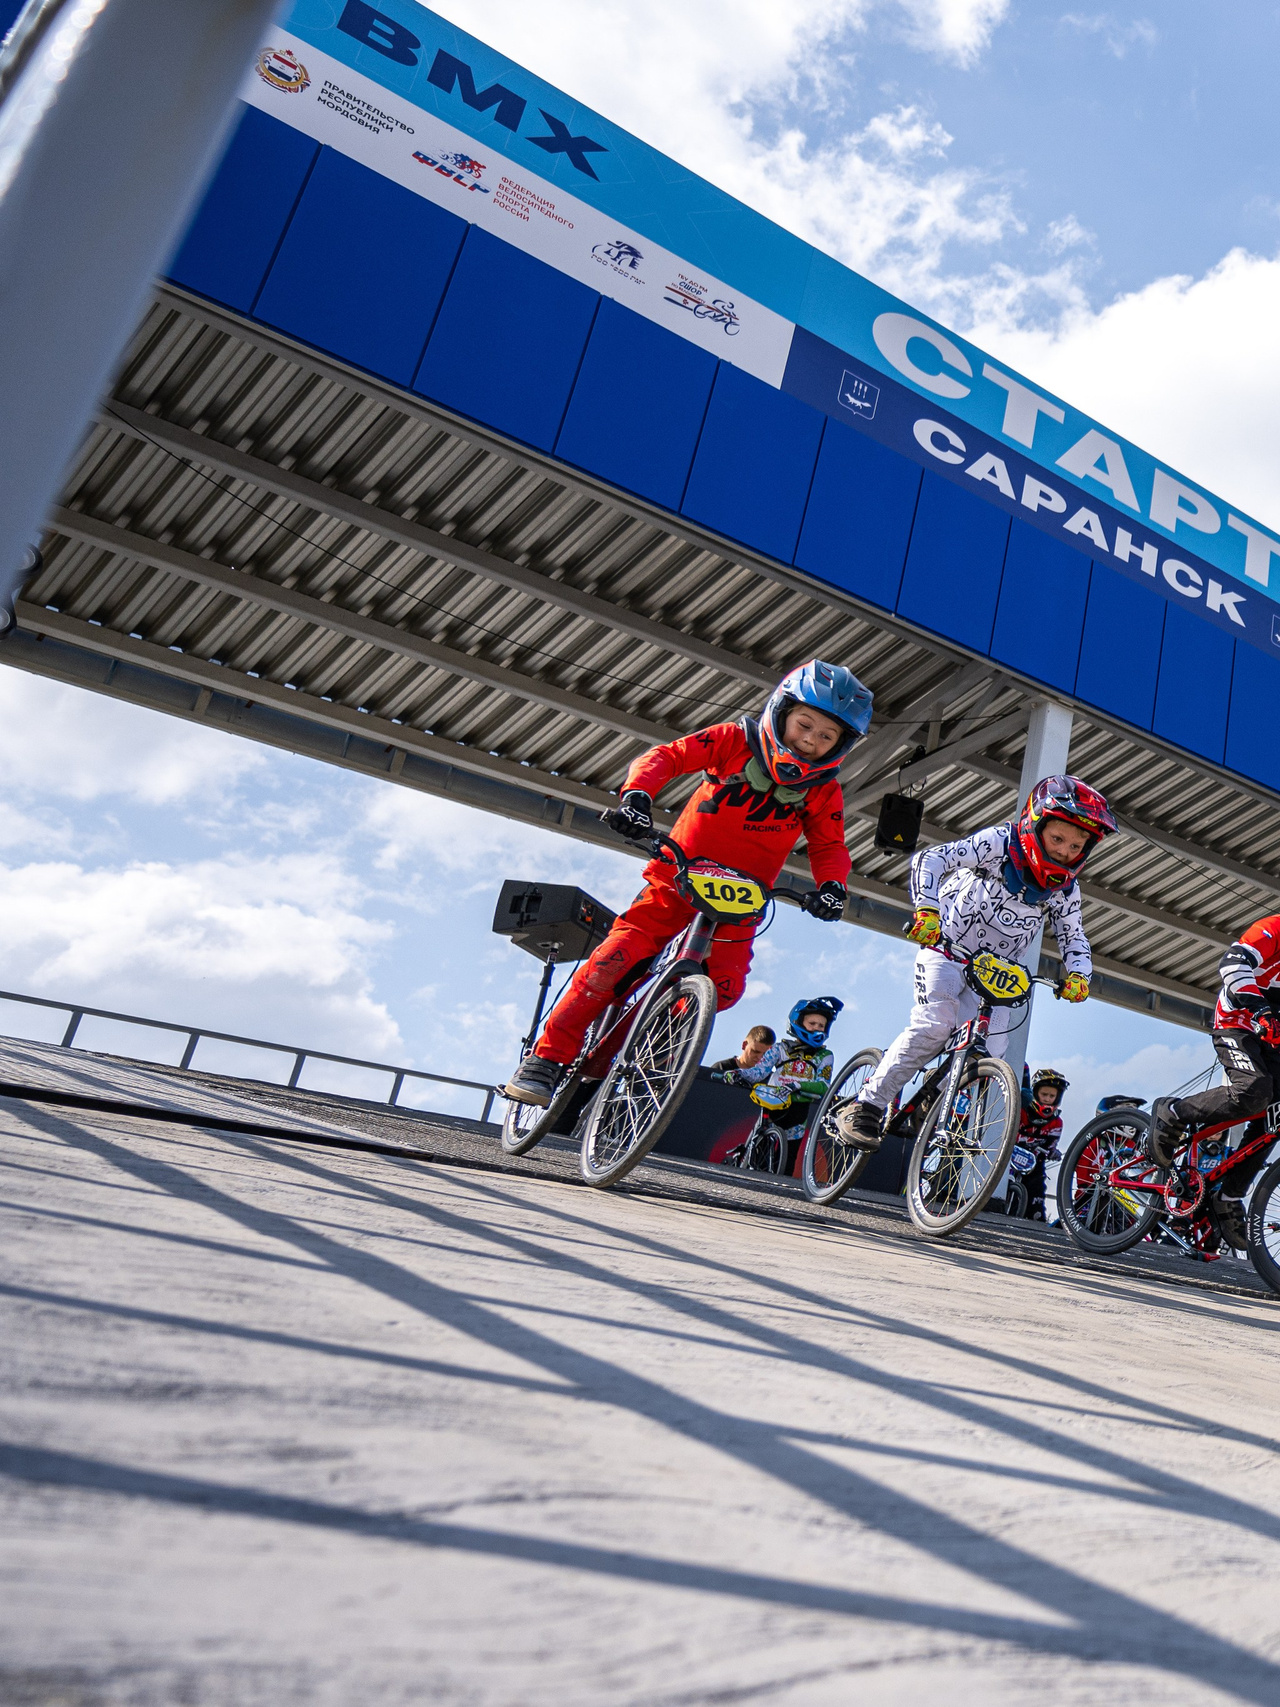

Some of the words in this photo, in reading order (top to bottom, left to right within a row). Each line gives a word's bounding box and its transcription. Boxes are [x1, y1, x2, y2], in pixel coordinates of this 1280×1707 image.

[324, 80, 415, 135] ПРАВИТЕЛЬСТВО
[336, 0, 610, 182] BMX
[317, 96, 380, 134] МОРДОВИЯ
[320, 88, 394, 133] РЕСПУБЛИКИ
[495, 191, 530, 214] СПОРТА
[498, 183, 574, 230] ВЕЛОСИПЕДНОГО
[501, 176, 556, 210] ФЕДЕРАЦИЯ
[492, 198, 530, 222] РОССИИ
[679, 281, 702, 296] СШОР
[913, 419, 1247, 627] САРАНСК
[743, 824, 781, 832] RACING
[704, 882, 754, 905] 102
[988, 966, 1019, 994] 702
[1065, 1208, 1081, 1232] AVIAN
[1253, 1213, 1262, 1246] AVIAN
